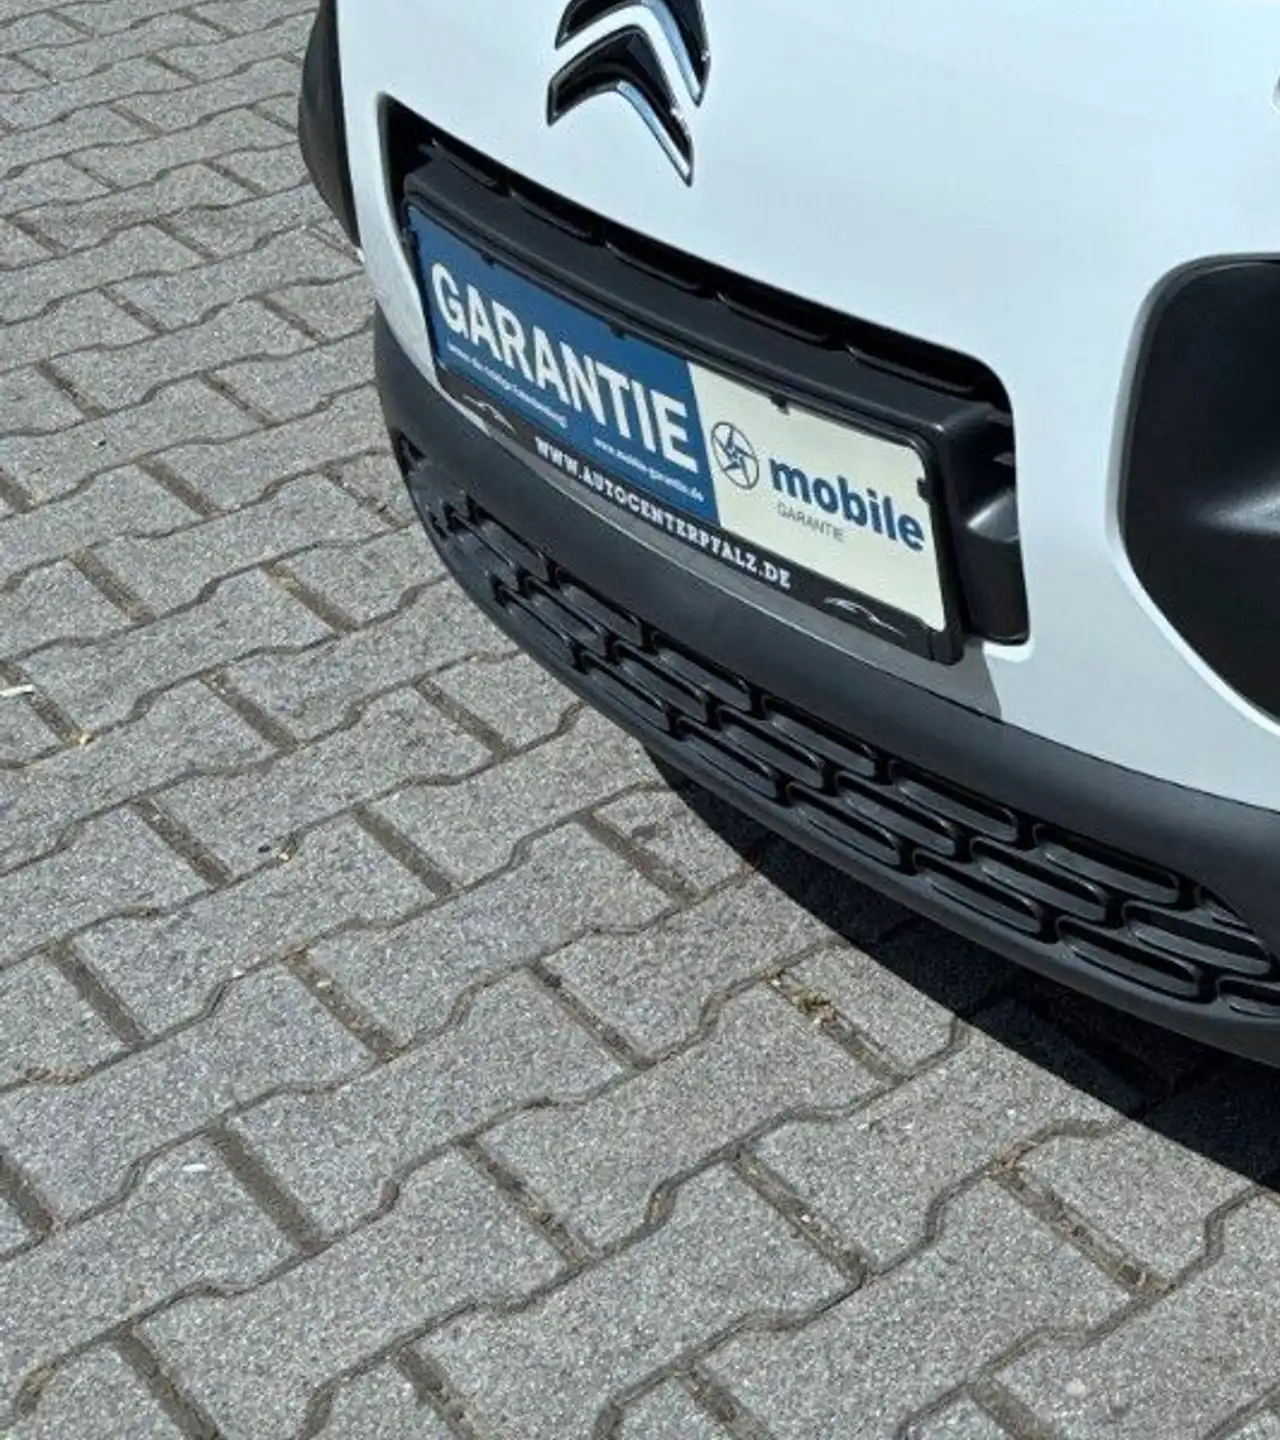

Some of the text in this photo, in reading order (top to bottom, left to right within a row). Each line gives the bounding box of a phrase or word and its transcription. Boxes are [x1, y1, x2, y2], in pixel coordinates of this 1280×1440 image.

[431, 263, 698, 473] GARANTIE
[768, 457, 926, 551] mobile
[776, 502, 846, 543] GARANTIE
